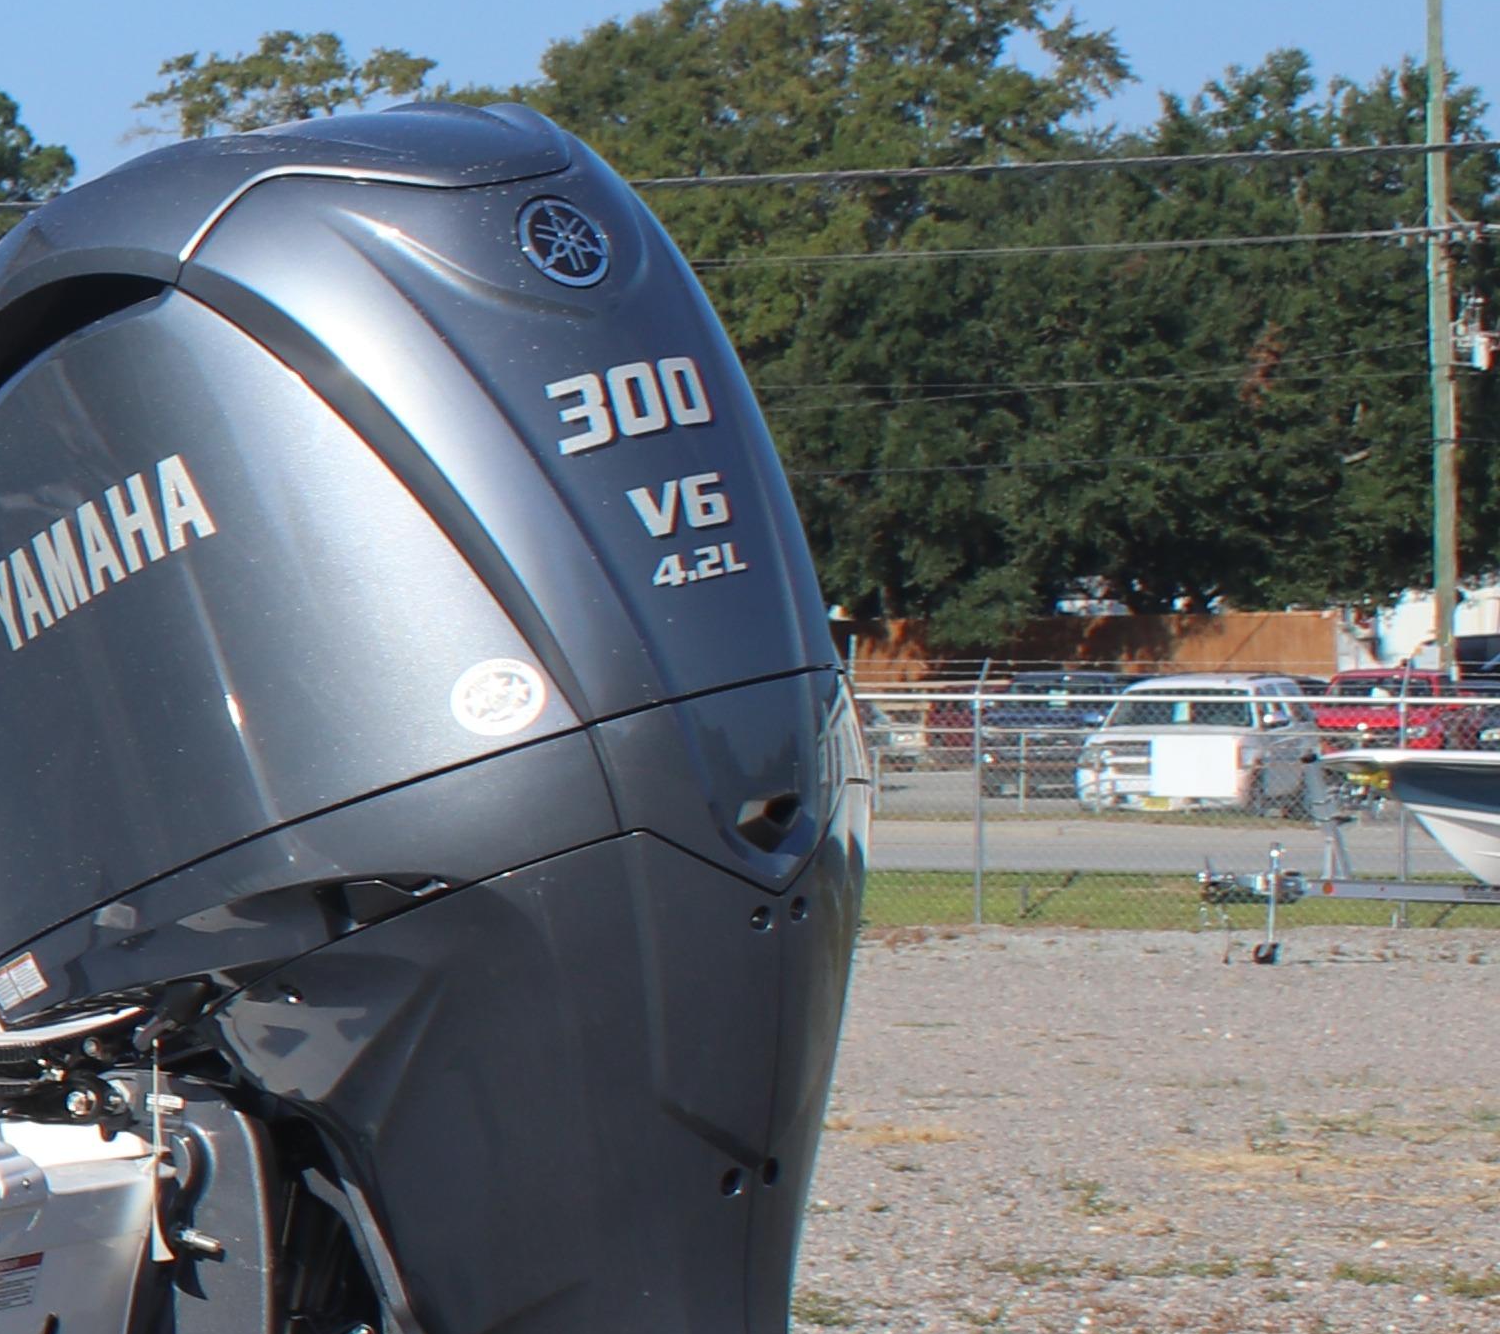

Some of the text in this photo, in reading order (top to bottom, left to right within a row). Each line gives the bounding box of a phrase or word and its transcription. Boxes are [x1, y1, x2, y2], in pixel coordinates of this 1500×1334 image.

[546, 357, 712, 455] 300
[626, 472, 730, 537] V6
[653, 543, 747, 587] 4.2L
